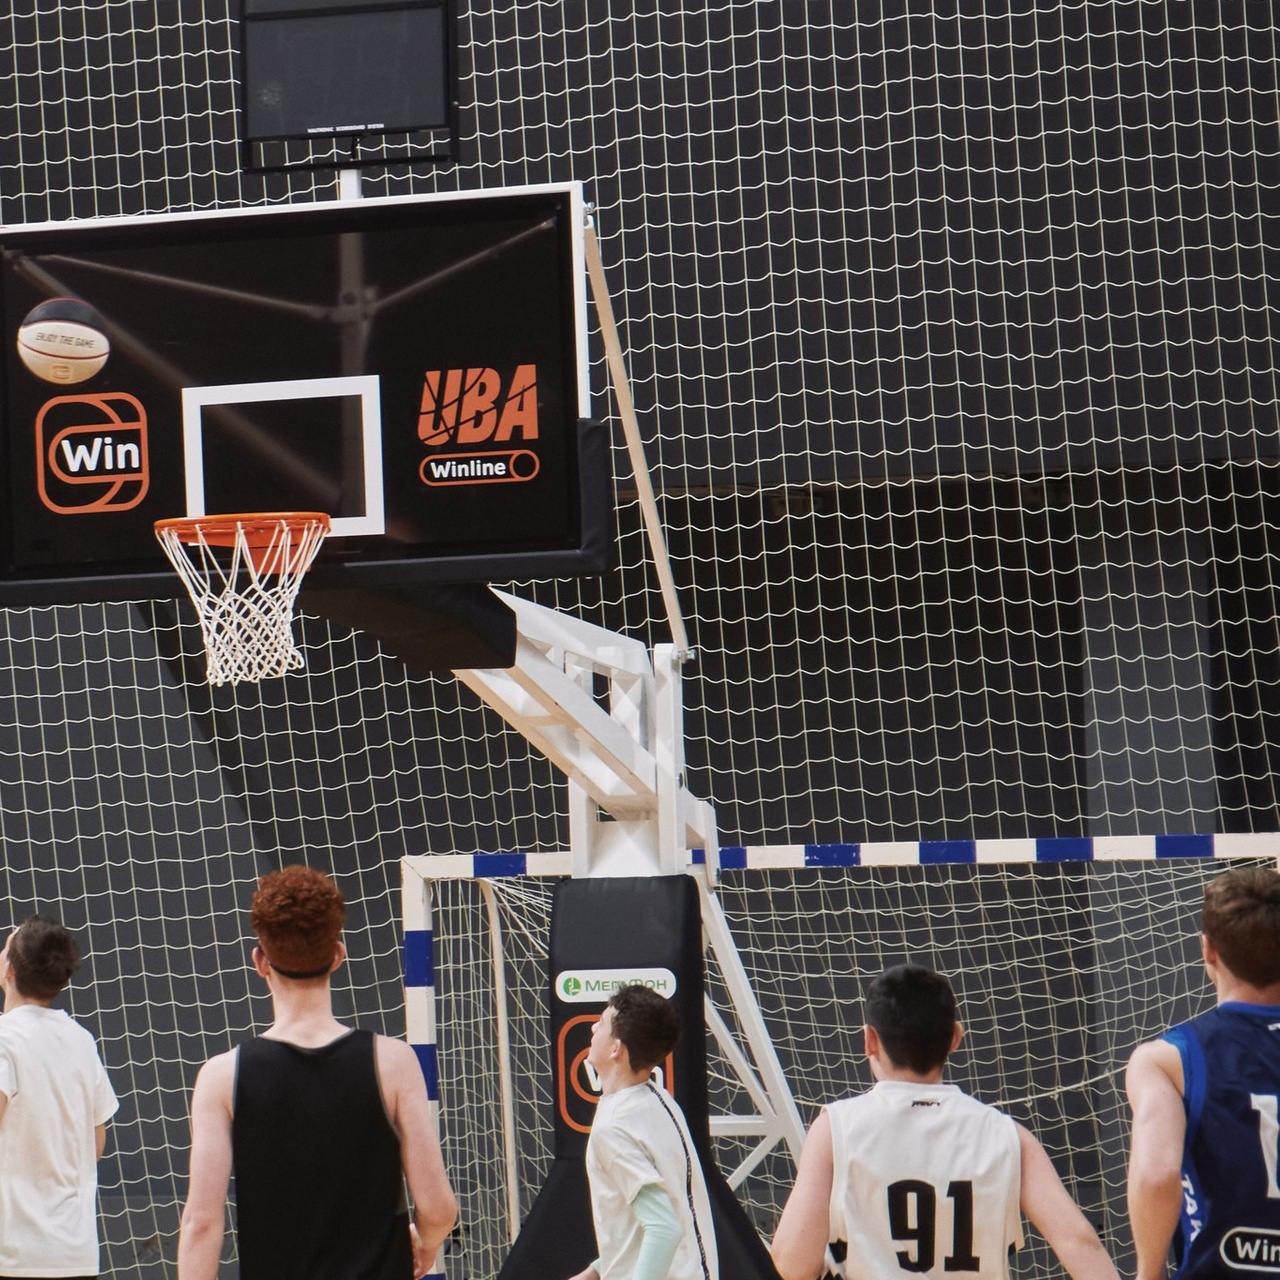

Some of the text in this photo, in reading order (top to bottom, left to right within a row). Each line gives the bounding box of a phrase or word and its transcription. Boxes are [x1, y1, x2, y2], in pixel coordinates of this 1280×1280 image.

[417, 364, 539, 446] UBA
[60, 437, 140, 472] Win
[430, 460, 506, 478] Winline
[887, 1179, 980, 1273] 91
